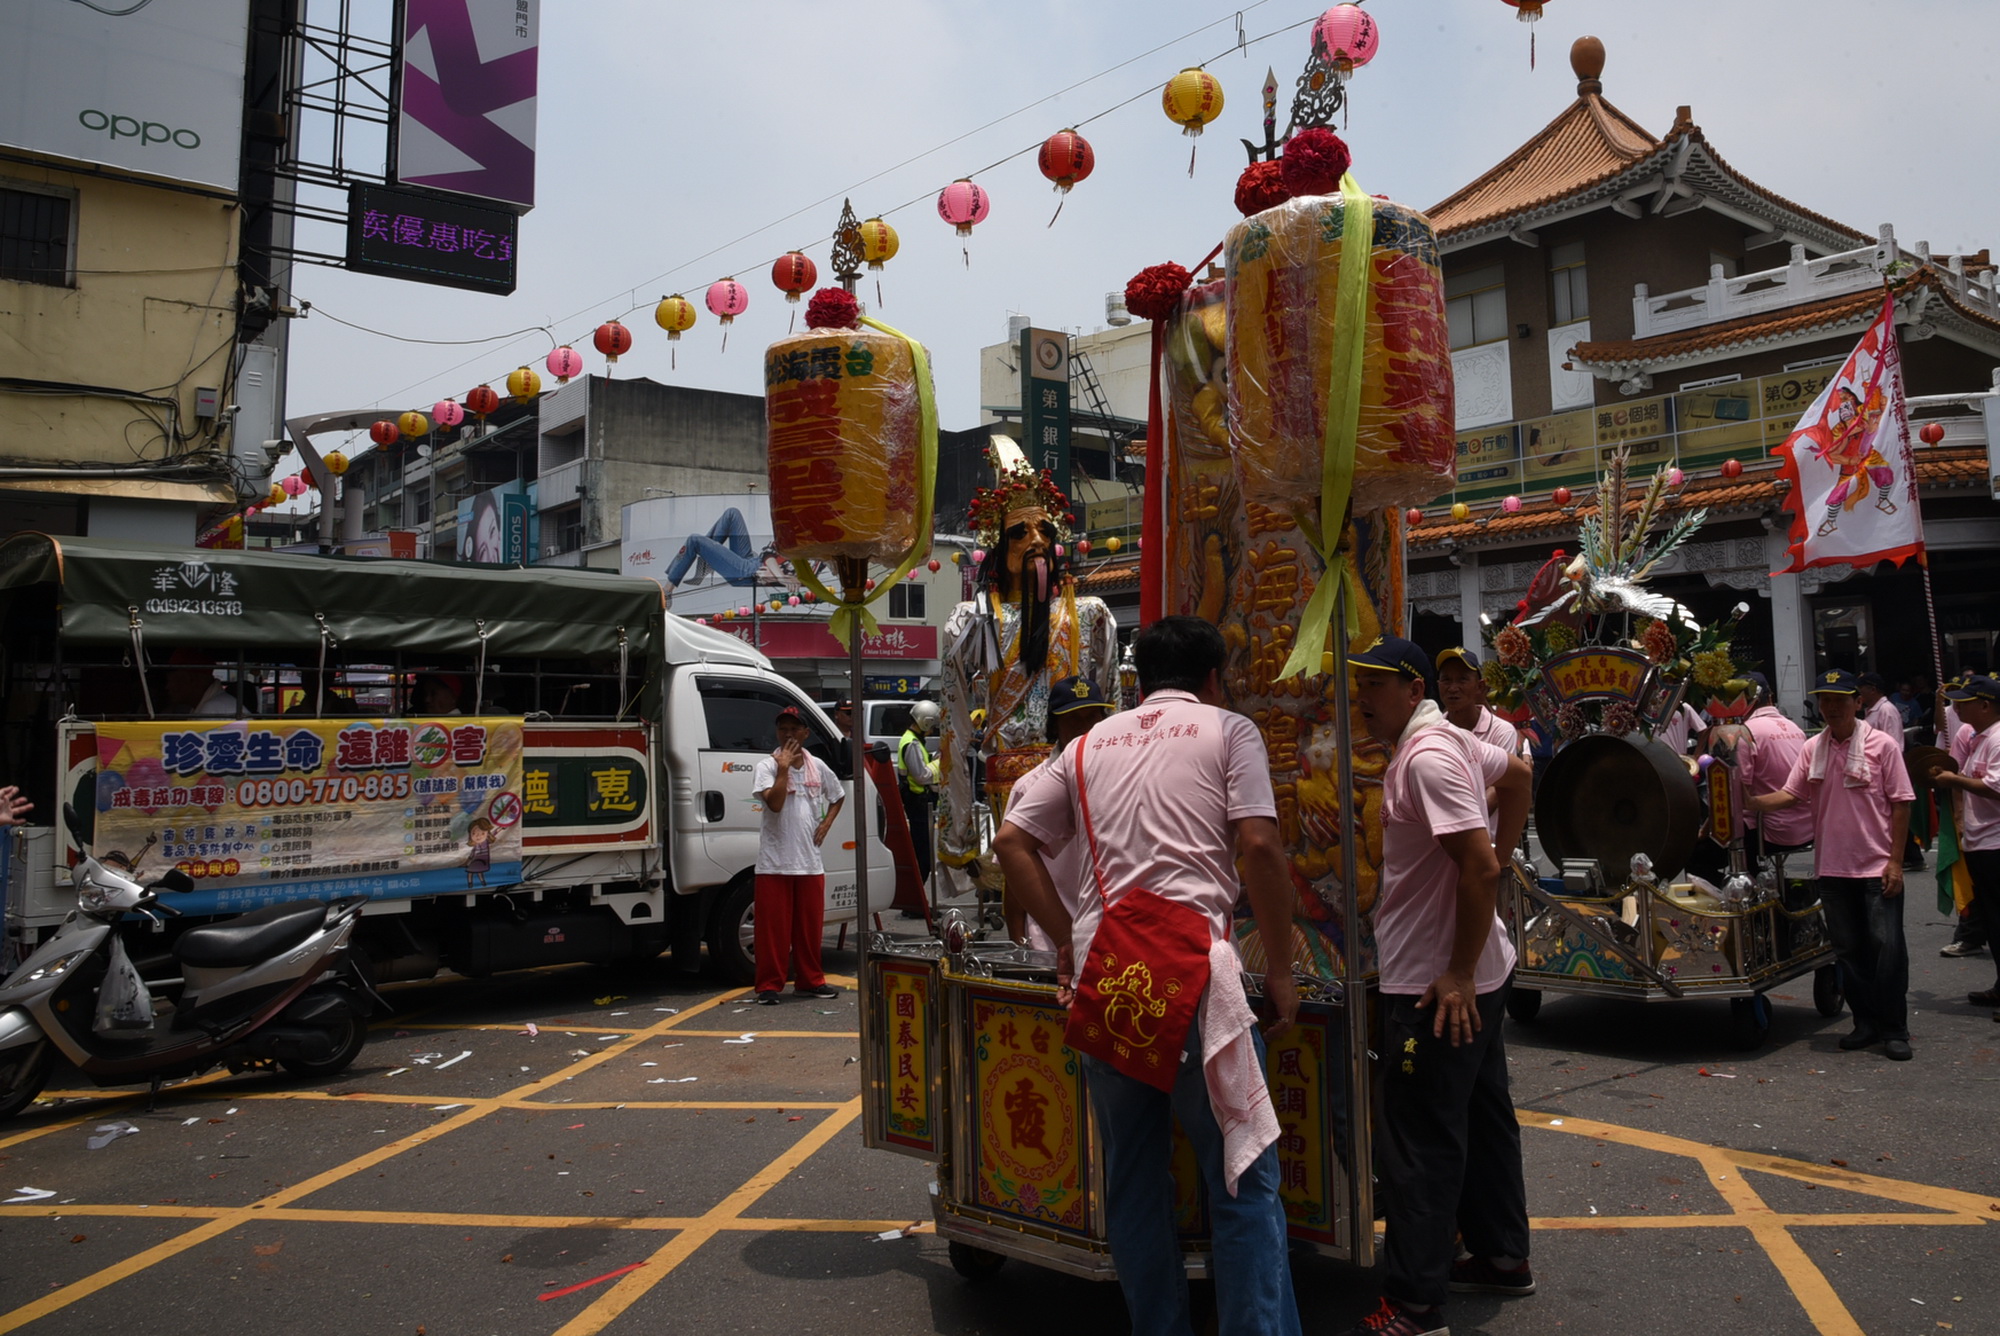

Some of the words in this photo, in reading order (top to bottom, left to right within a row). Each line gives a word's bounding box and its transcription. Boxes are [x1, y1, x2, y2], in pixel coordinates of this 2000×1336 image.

[1042, 388, 1060, 471] 第一銀行
[1598, 403, 1659, 429] 第e個網
[151, 567, 178, 592] 華
[211, 570, 239, 597] 隆
[1943, 612, 1981, 627] ATM
[897, 678, 908, 693] 3
[162, 730, 324, 774] 珍愛生命
[238, 775, 410, 806] 0800-770-885
[895, 993, 920, 1113] 國泰民安
[1275, 1047, 1311, 1196] 風調雨順
